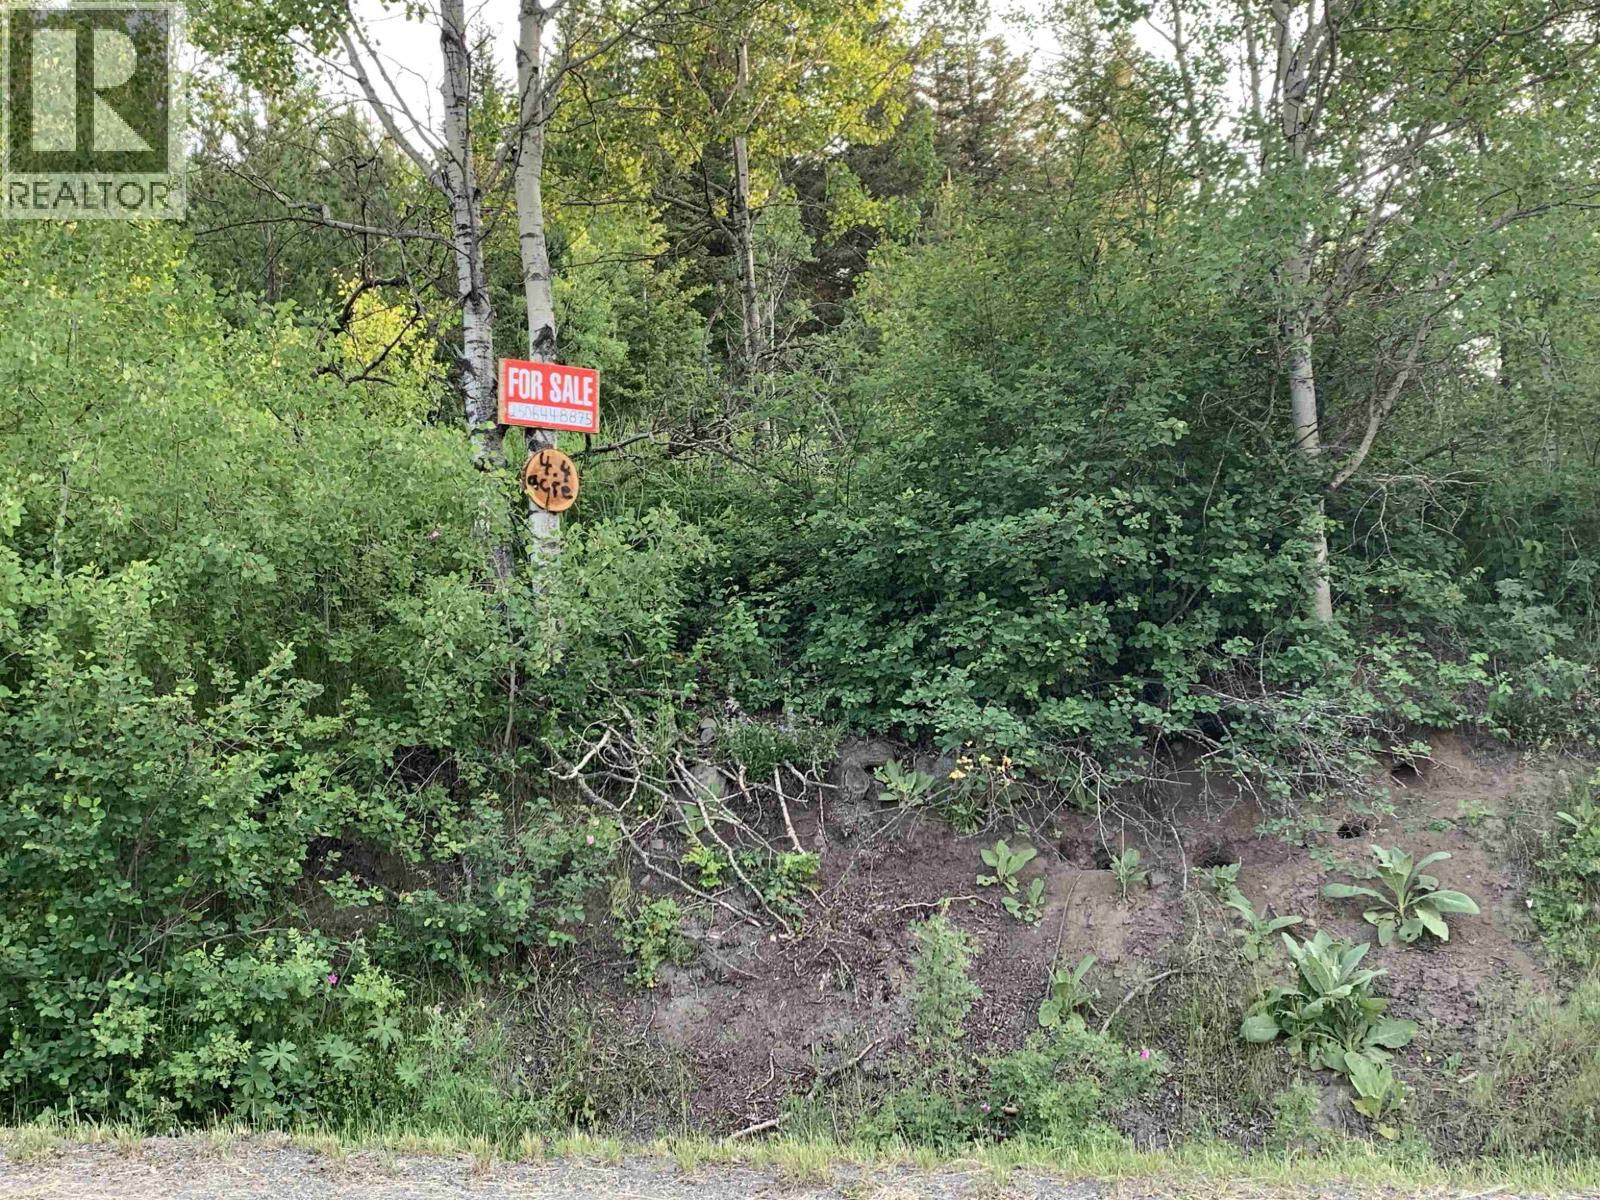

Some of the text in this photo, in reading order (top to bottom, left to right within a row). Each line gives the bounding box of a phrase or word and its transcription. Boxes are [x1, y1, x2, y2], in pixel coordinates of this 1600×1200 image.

[508, 367, 593, 406] FOR SALE
[539, 452, 571, 482] 4.4
[527, 475, 574, 499] acre
